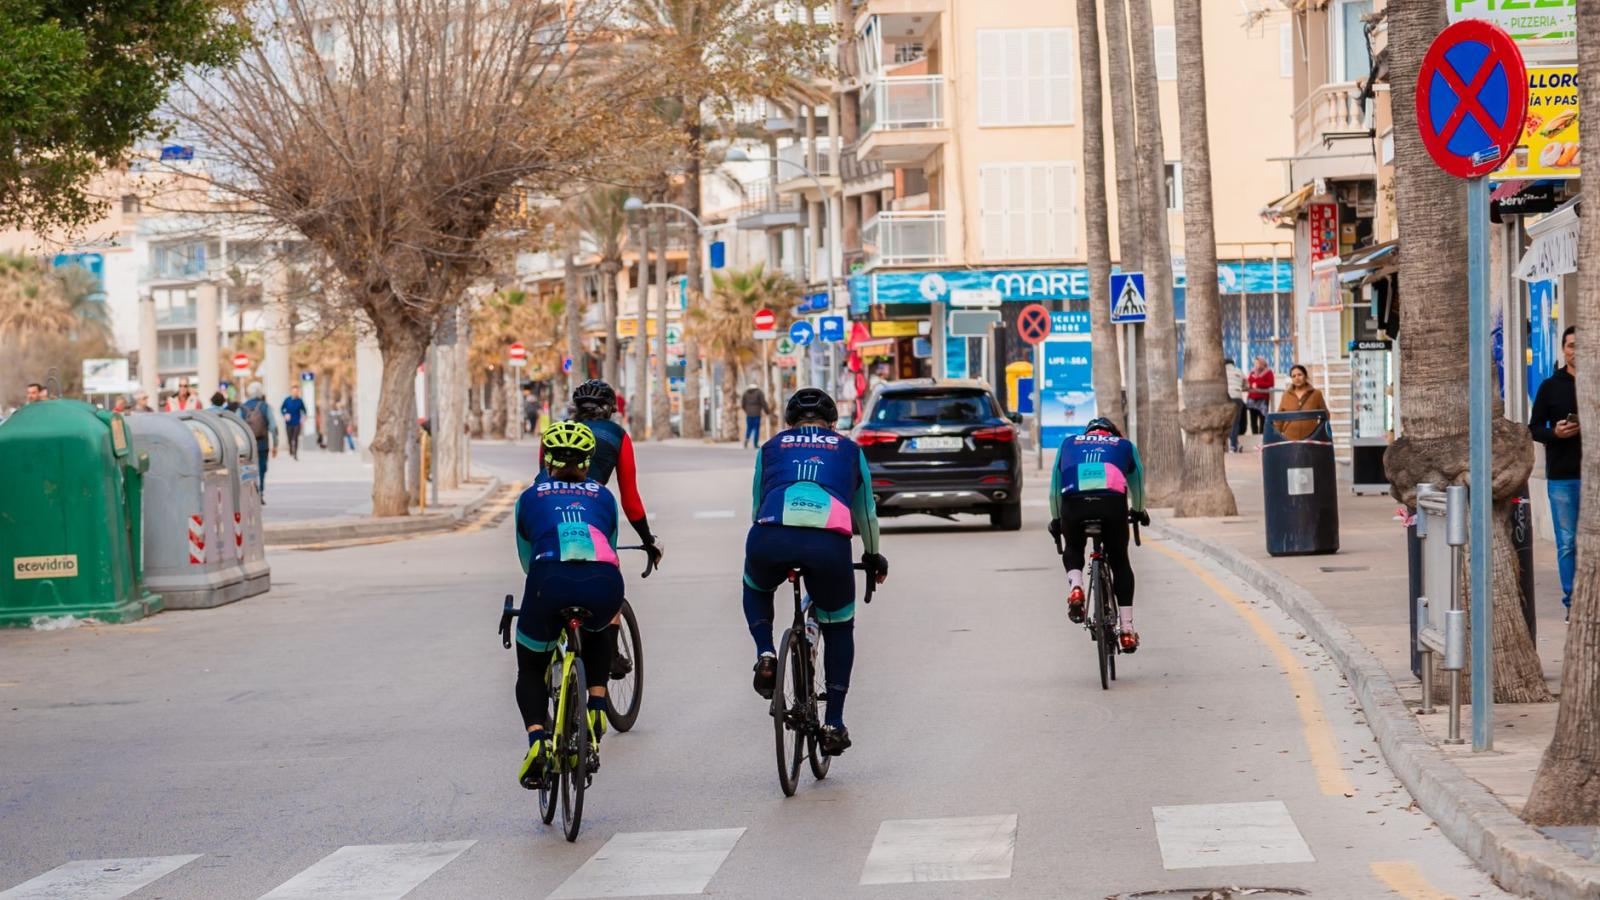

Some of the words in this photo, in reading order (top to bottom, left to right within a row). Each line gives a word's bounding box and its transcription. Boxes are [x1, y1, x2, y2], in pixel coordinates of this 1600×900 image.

[1511, 15, 1557, 28] PIZZERIA
[1545, 96, 1552, 105] Y
[992, 273, 1086, 296] MARE
[781, 434, 839, 444] anke
[537, 481, 600, 492] anke
[17, 558, 75, 572] ecovidrio
